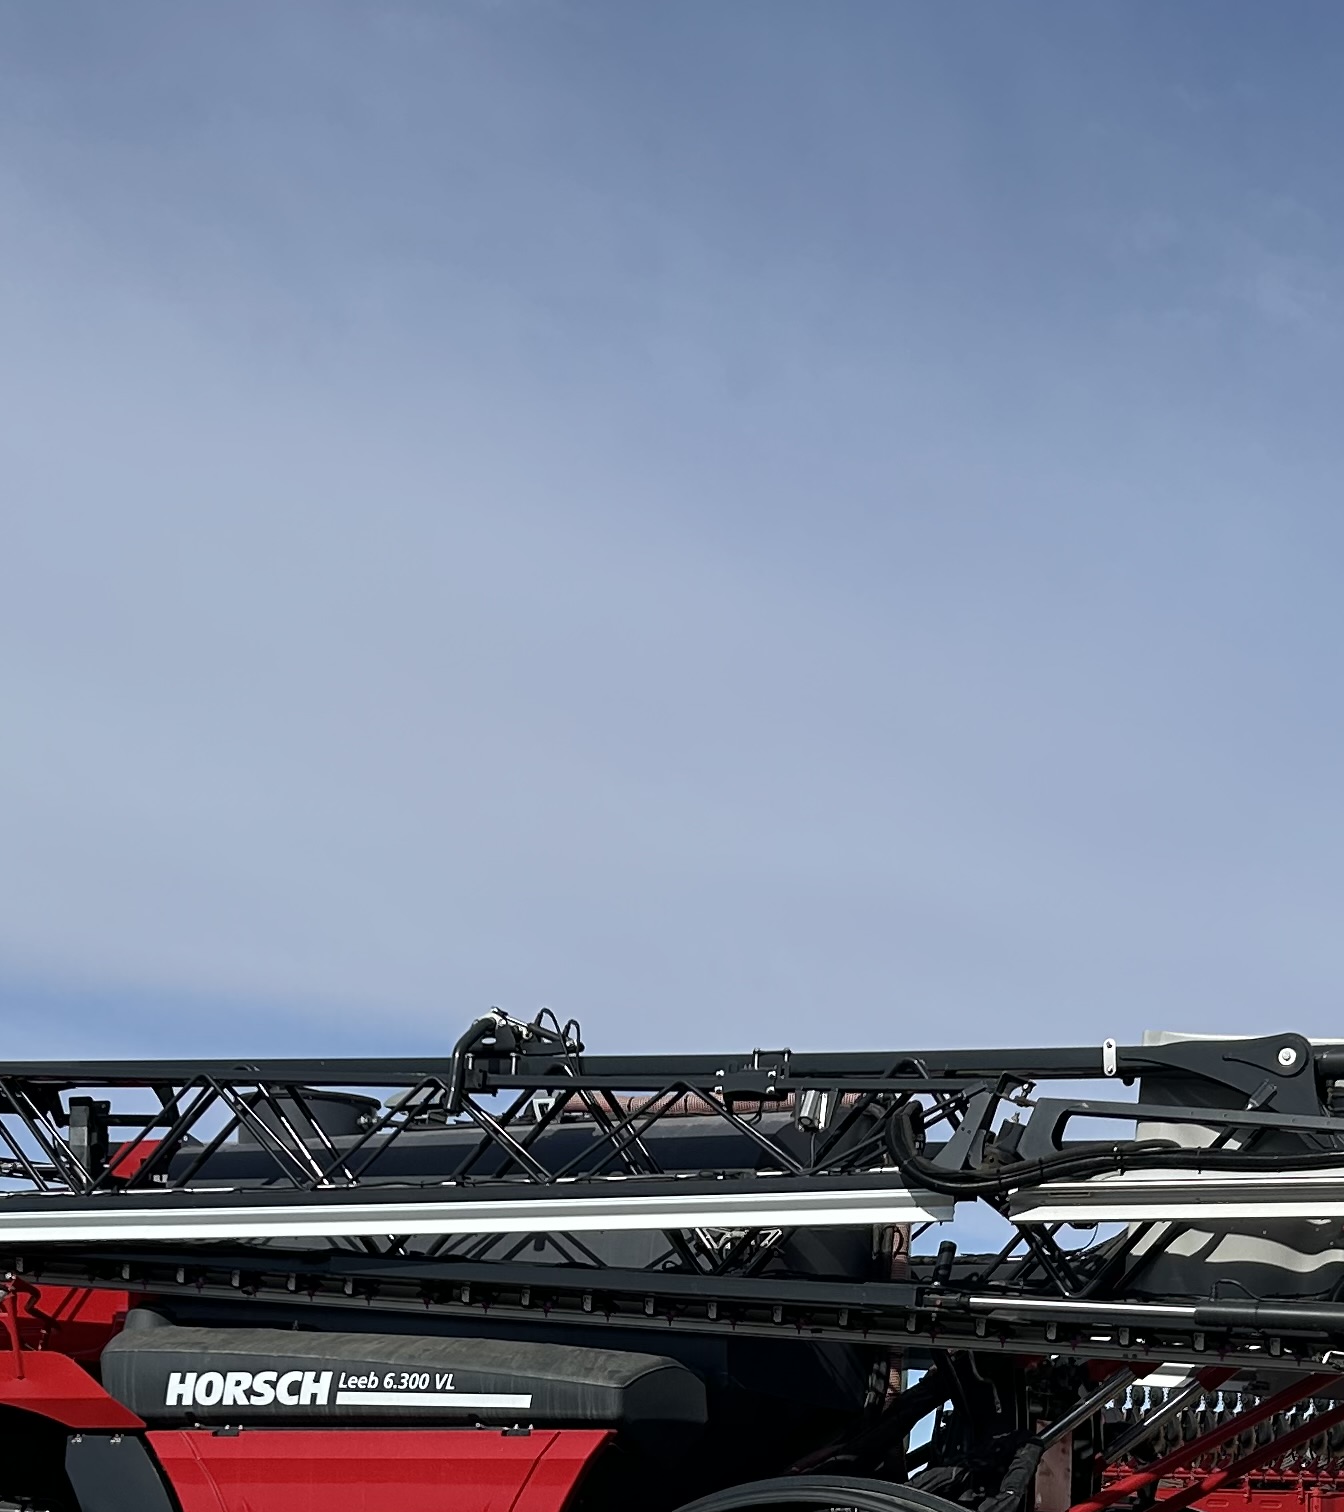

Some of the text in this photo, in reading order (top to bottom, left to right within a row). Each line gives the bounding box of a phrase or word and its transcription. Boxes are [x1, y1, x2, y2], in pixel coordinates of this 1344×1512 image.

[165, 1370, 456, 1406] HORSCH Leeb 6.300 VL
